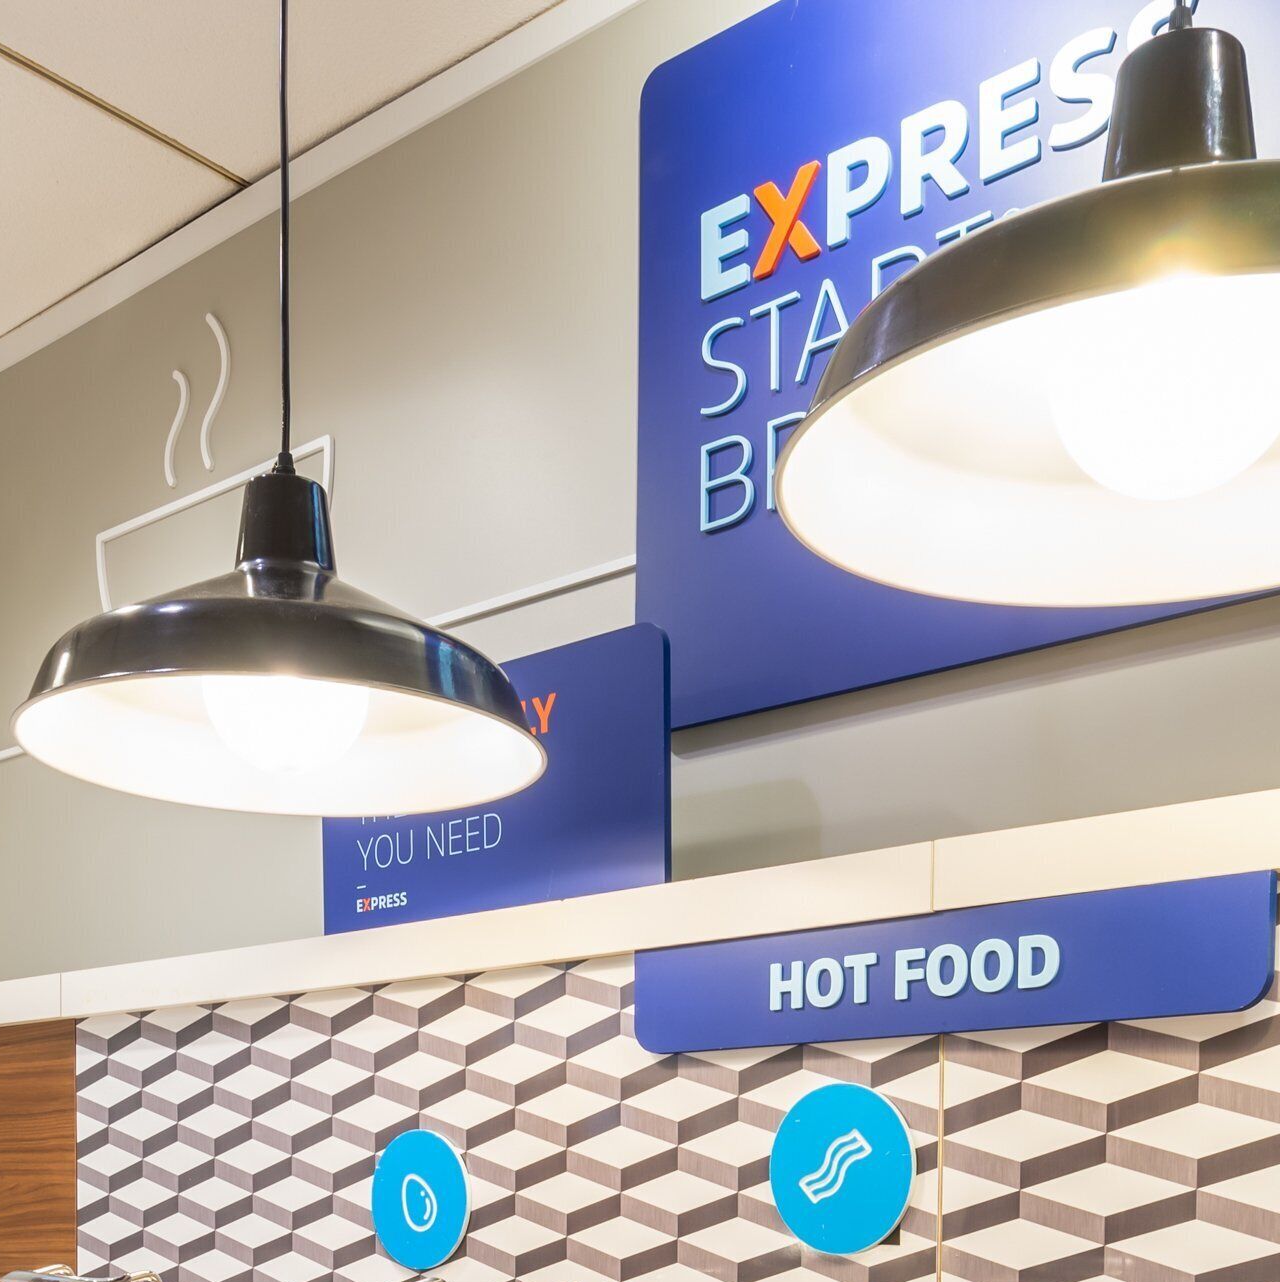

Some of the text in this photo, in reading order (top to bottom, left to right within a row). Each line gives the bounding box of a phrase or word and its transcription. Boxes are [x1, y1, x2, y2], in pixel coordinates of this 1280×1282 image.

[357, 813, 502, 871] YOU NEED
[356, 892, 407, 913] EXPRESS
[769, 934, 1061, 1012] HOT FOOD
